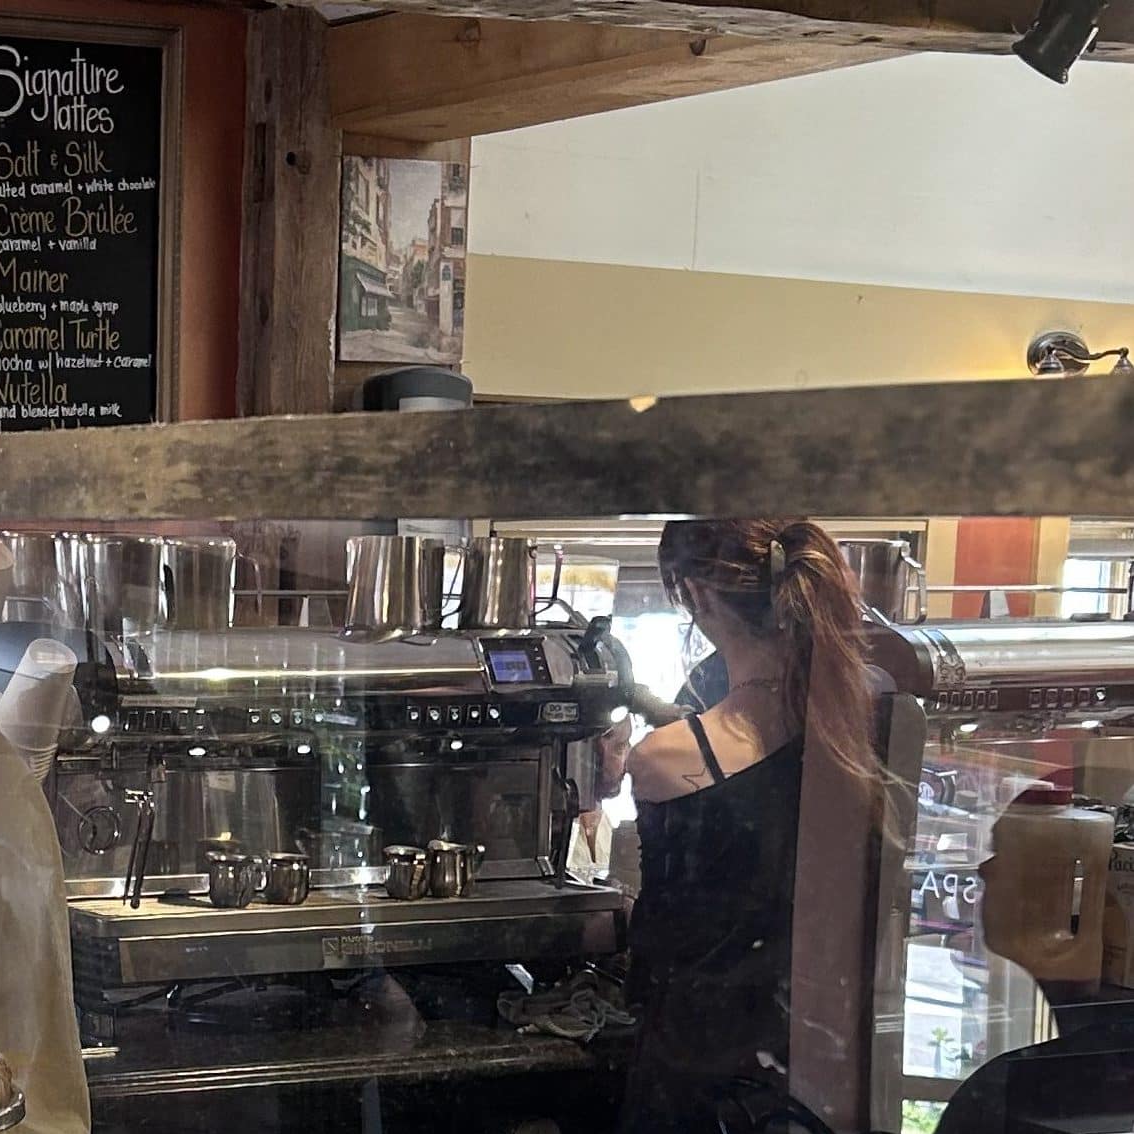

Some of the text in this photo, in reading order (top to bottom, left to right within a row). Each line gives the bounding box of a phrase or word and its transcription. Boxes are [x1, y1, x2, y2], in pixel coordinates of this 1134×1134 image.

[53, 94, 115, 134] lattes
[63, 140, 112, 177] Silk
[61, 194, 138, 237] Brûlée
[58, 235, 97, 251] vanilla
[68, 316, 121, 351] Turtle
